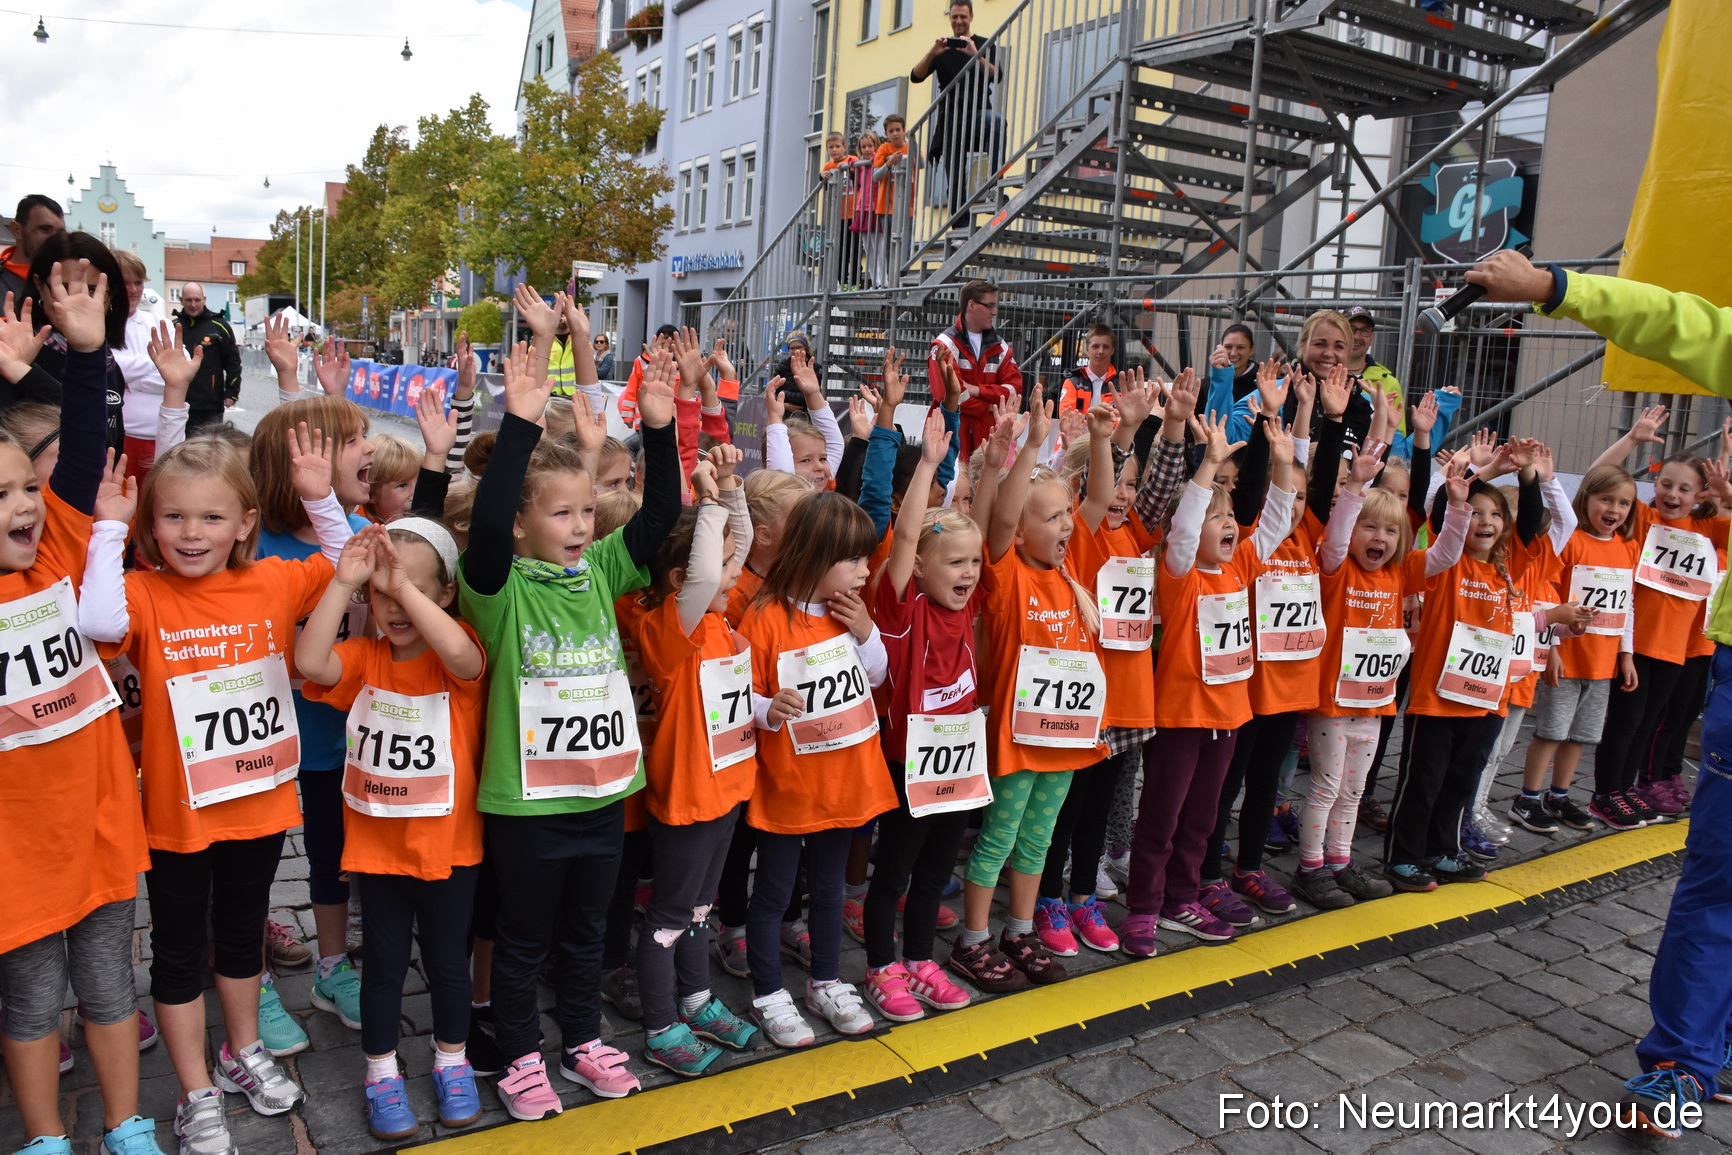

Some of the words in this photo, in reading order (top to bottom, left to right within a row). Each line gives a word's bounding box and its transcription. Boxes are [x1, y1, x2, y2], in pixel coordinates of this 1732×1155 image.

[684, 250, 742, 272] Raiffeisenbank
[1653, 545, 1707, 576] 7141
[1659, 573, 1689, 588] Hannah
[1582, 586, 1627, 609] 7212
[10, 601, 60, 628] BOCK
[1270, 600, 1317, 627] 7272
[1283, 632, 1316, 651] LEA
[556, 645, 616, 667] BOCK
[816, 644, 847, 663] BOCK
[1458, 648, 1502, 680] 7034
[1059, 659, 1088, 670] BOCK
[1354, 653, 1402, 677] 7050
[224, 671, 264, 691] BOCK
[796, 664, 865, 714] 7220
[1367, 685, 1385, 695] Frida
[1463, 681, 1487, 695] Patricia
[572, 685, 610, 699] BOCK
[1032, 677, 1096, 711] 7132
[32, 692, 77, 719] Emma
[380, 702, 421, 719] BOCK
[195, 696, 285, 751] 7032
[541, 710, 625, 752] 7260
[814, 720, 843, 737] Julia
[1040, 718, 1080, 732] Franziska
[186, 751, 195, 759] B1
[357, 724, 436, 771] 7153
[235, 754, 274, 773] Paula
[918, 741, 976, 776] 7077
[364, 779, 408, 797] Helena
[935, 783, 955, 796] Leni
